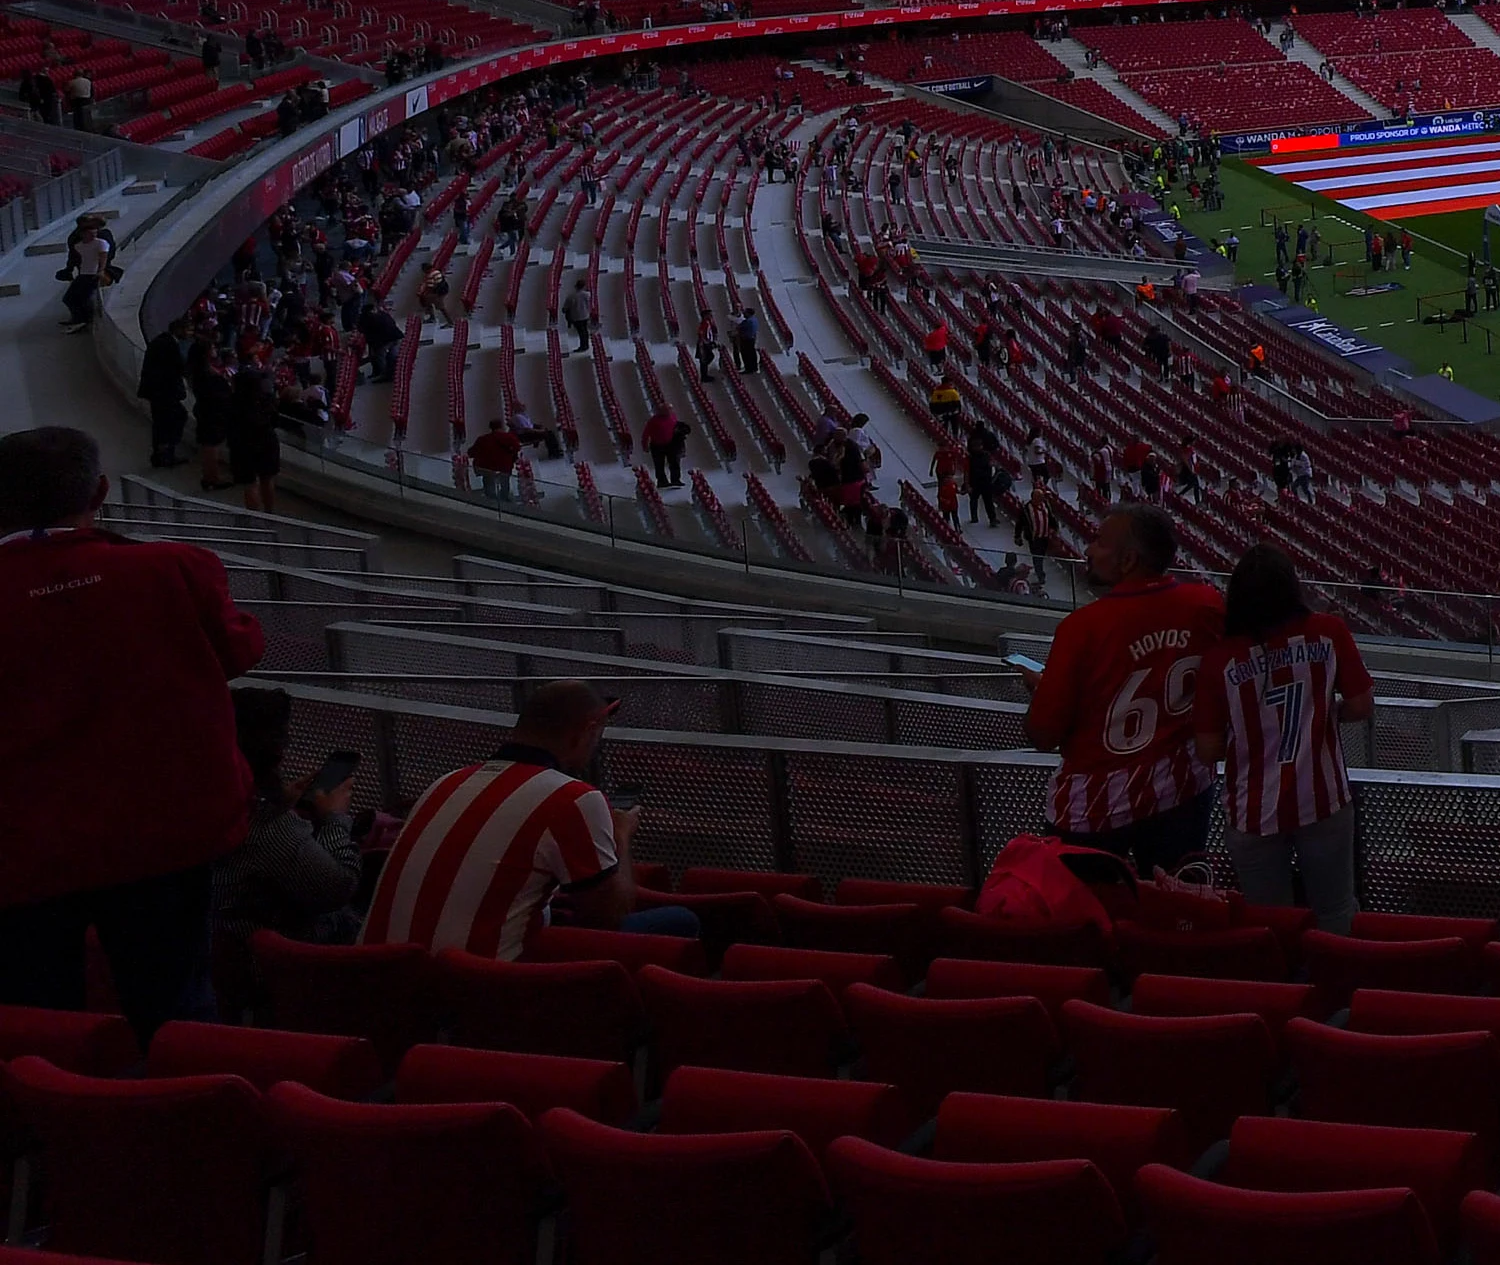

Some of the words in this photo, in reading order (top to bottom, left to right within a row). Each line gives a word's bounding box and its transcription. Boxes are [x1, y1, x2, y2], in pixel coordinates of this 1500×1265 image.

[1350, 130, 1375, 142] PROUD
[1376, 128, 1408, 140] SPONSOR
[1408, 127, 1418, 136] OF
[1429, 123, 1461, 134] WANDA
[28, 582, 64, 599] POLO
[67, 573, 102, 590] CLUB
[1128, 628, 1191, 662] HOYOS
[1227, 642, 1330, 686] GRIEZMANN
[1264, 681, 1304, 764] 7
